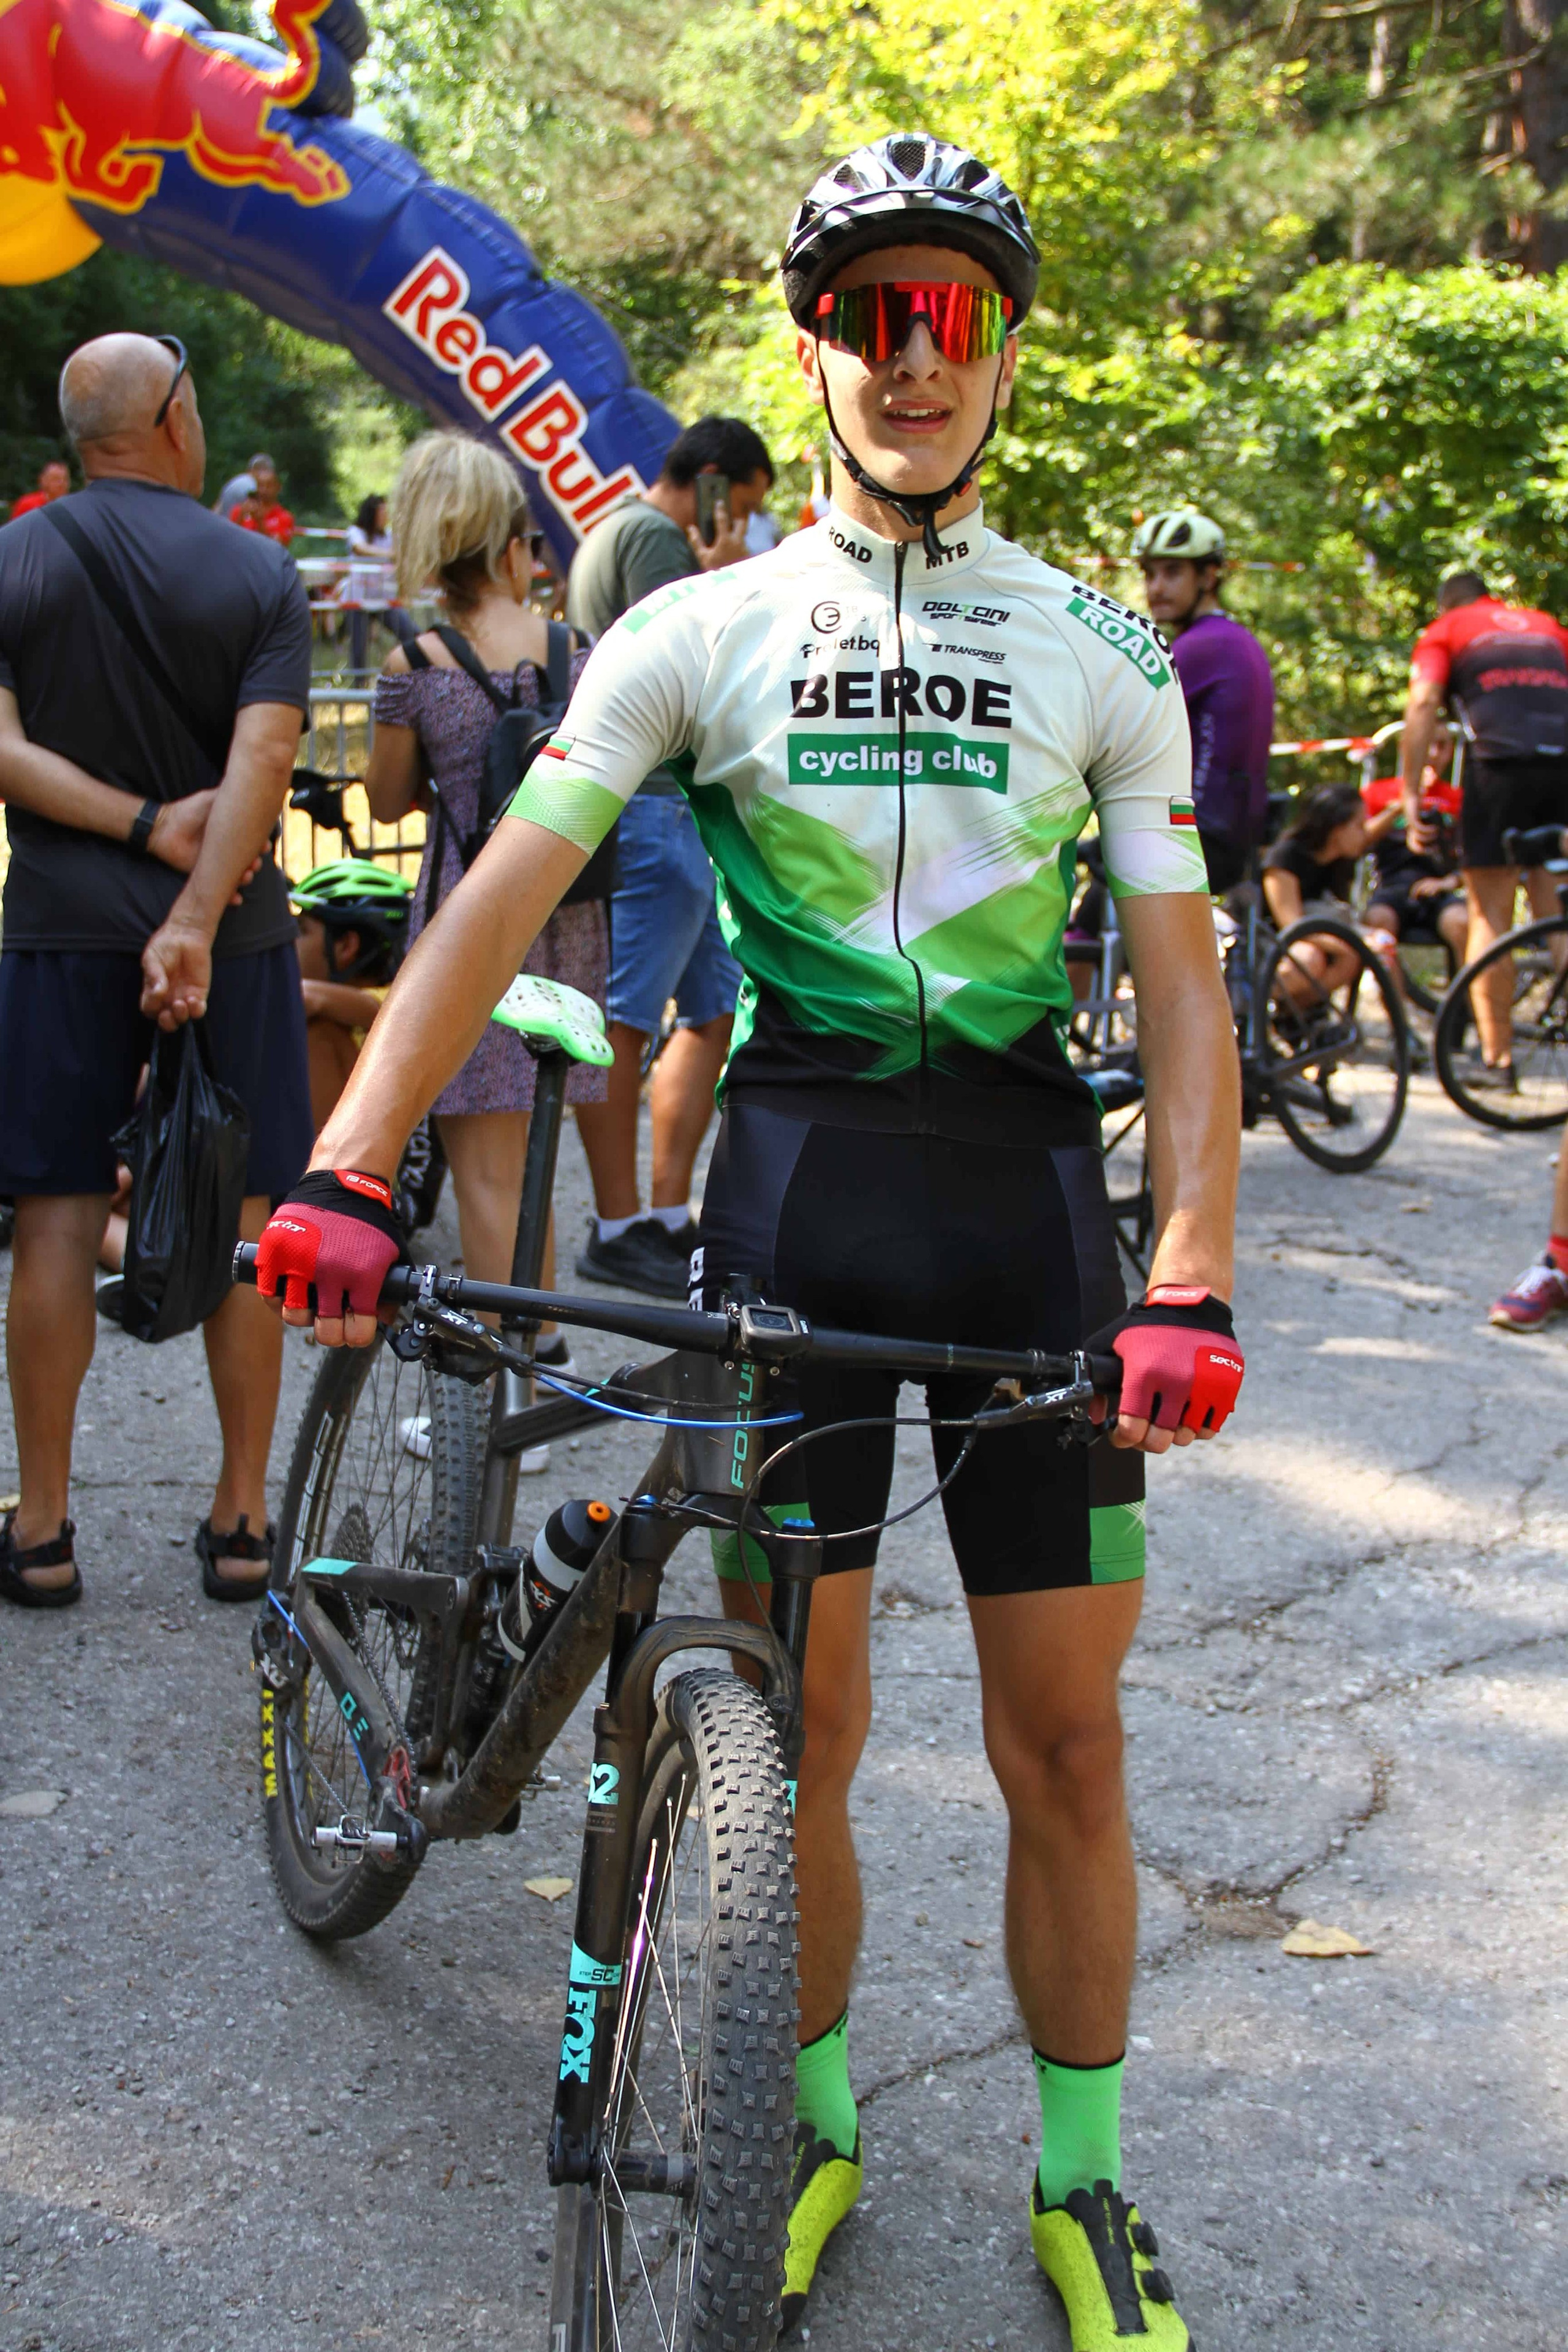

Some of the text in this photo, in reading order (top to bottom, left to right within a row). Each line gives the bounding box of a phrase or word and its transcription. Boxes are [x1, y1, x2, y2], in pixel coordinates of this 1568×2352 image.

[383, 246, 553, 422] Red
[828, 526, 873, 564] ROAD
[925, 541, 970, 570] MTB
[944, 644, 1007, 661] TRANSPRESS
[1079, 606, 1161, 676] ROAD
[791, 666, 1012, 729] BEROE
[799, 745, 998, 779] cycling club
[559, 1987, 598, 2084] FOX
